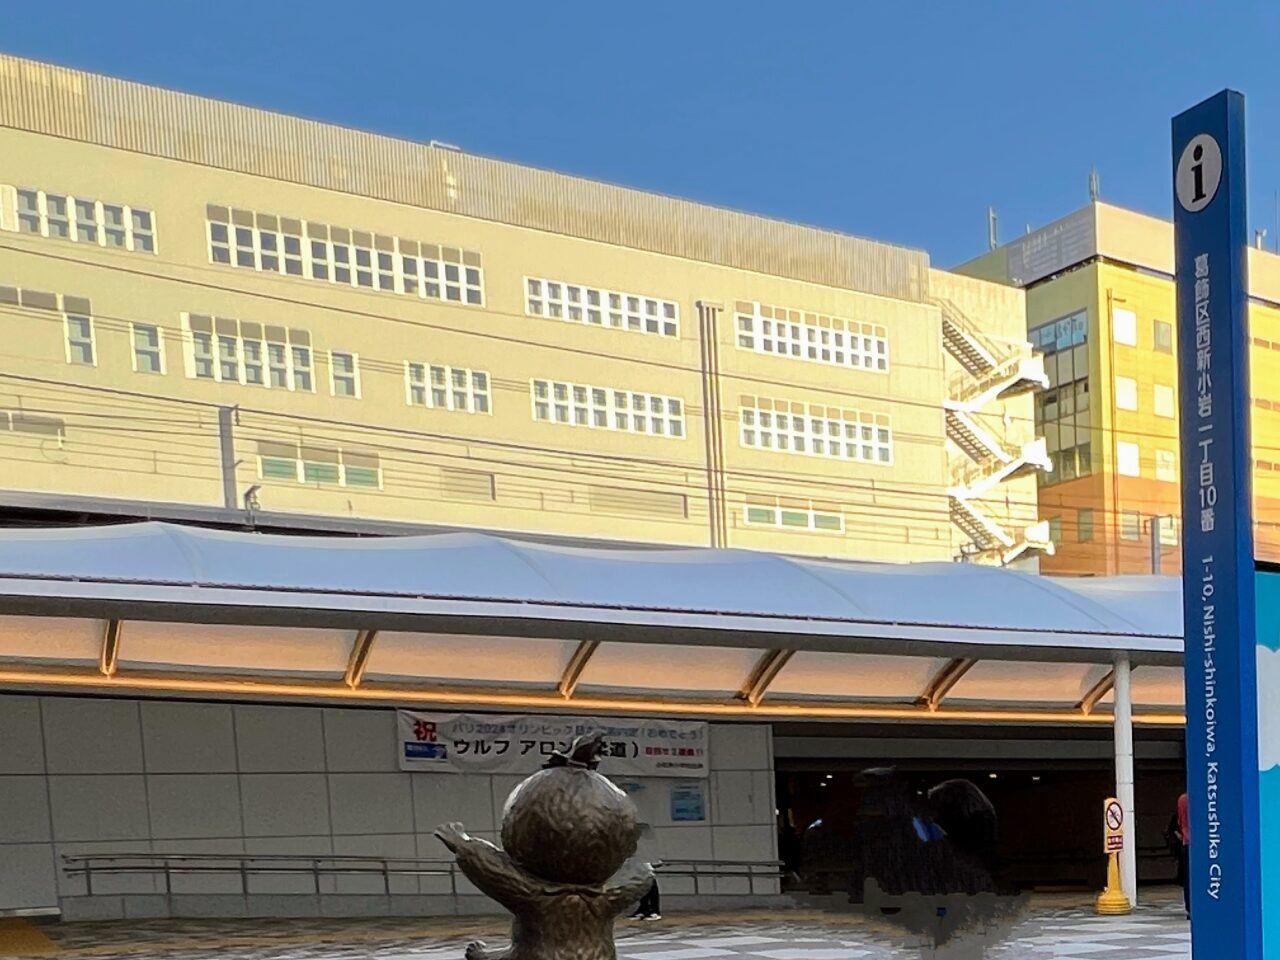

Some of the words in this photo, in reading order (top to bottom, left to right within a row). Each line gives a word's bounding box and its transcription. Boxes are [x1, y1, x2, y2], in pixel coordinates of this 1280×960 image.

[1193, 253, 1217, 532] 葛飾区西新小岩一丁目10番
[1201, 555, 1214, 601] 1-10,
[1202, 603, 1218, 757] Nishi-shinkoiwa,
[413, 720, 438, 742] 祝
[453, 739, 510, 755] ウルフ
[1206, 761, 1221, 859] Katsushika
[1207, 863, 1222, 900] City
